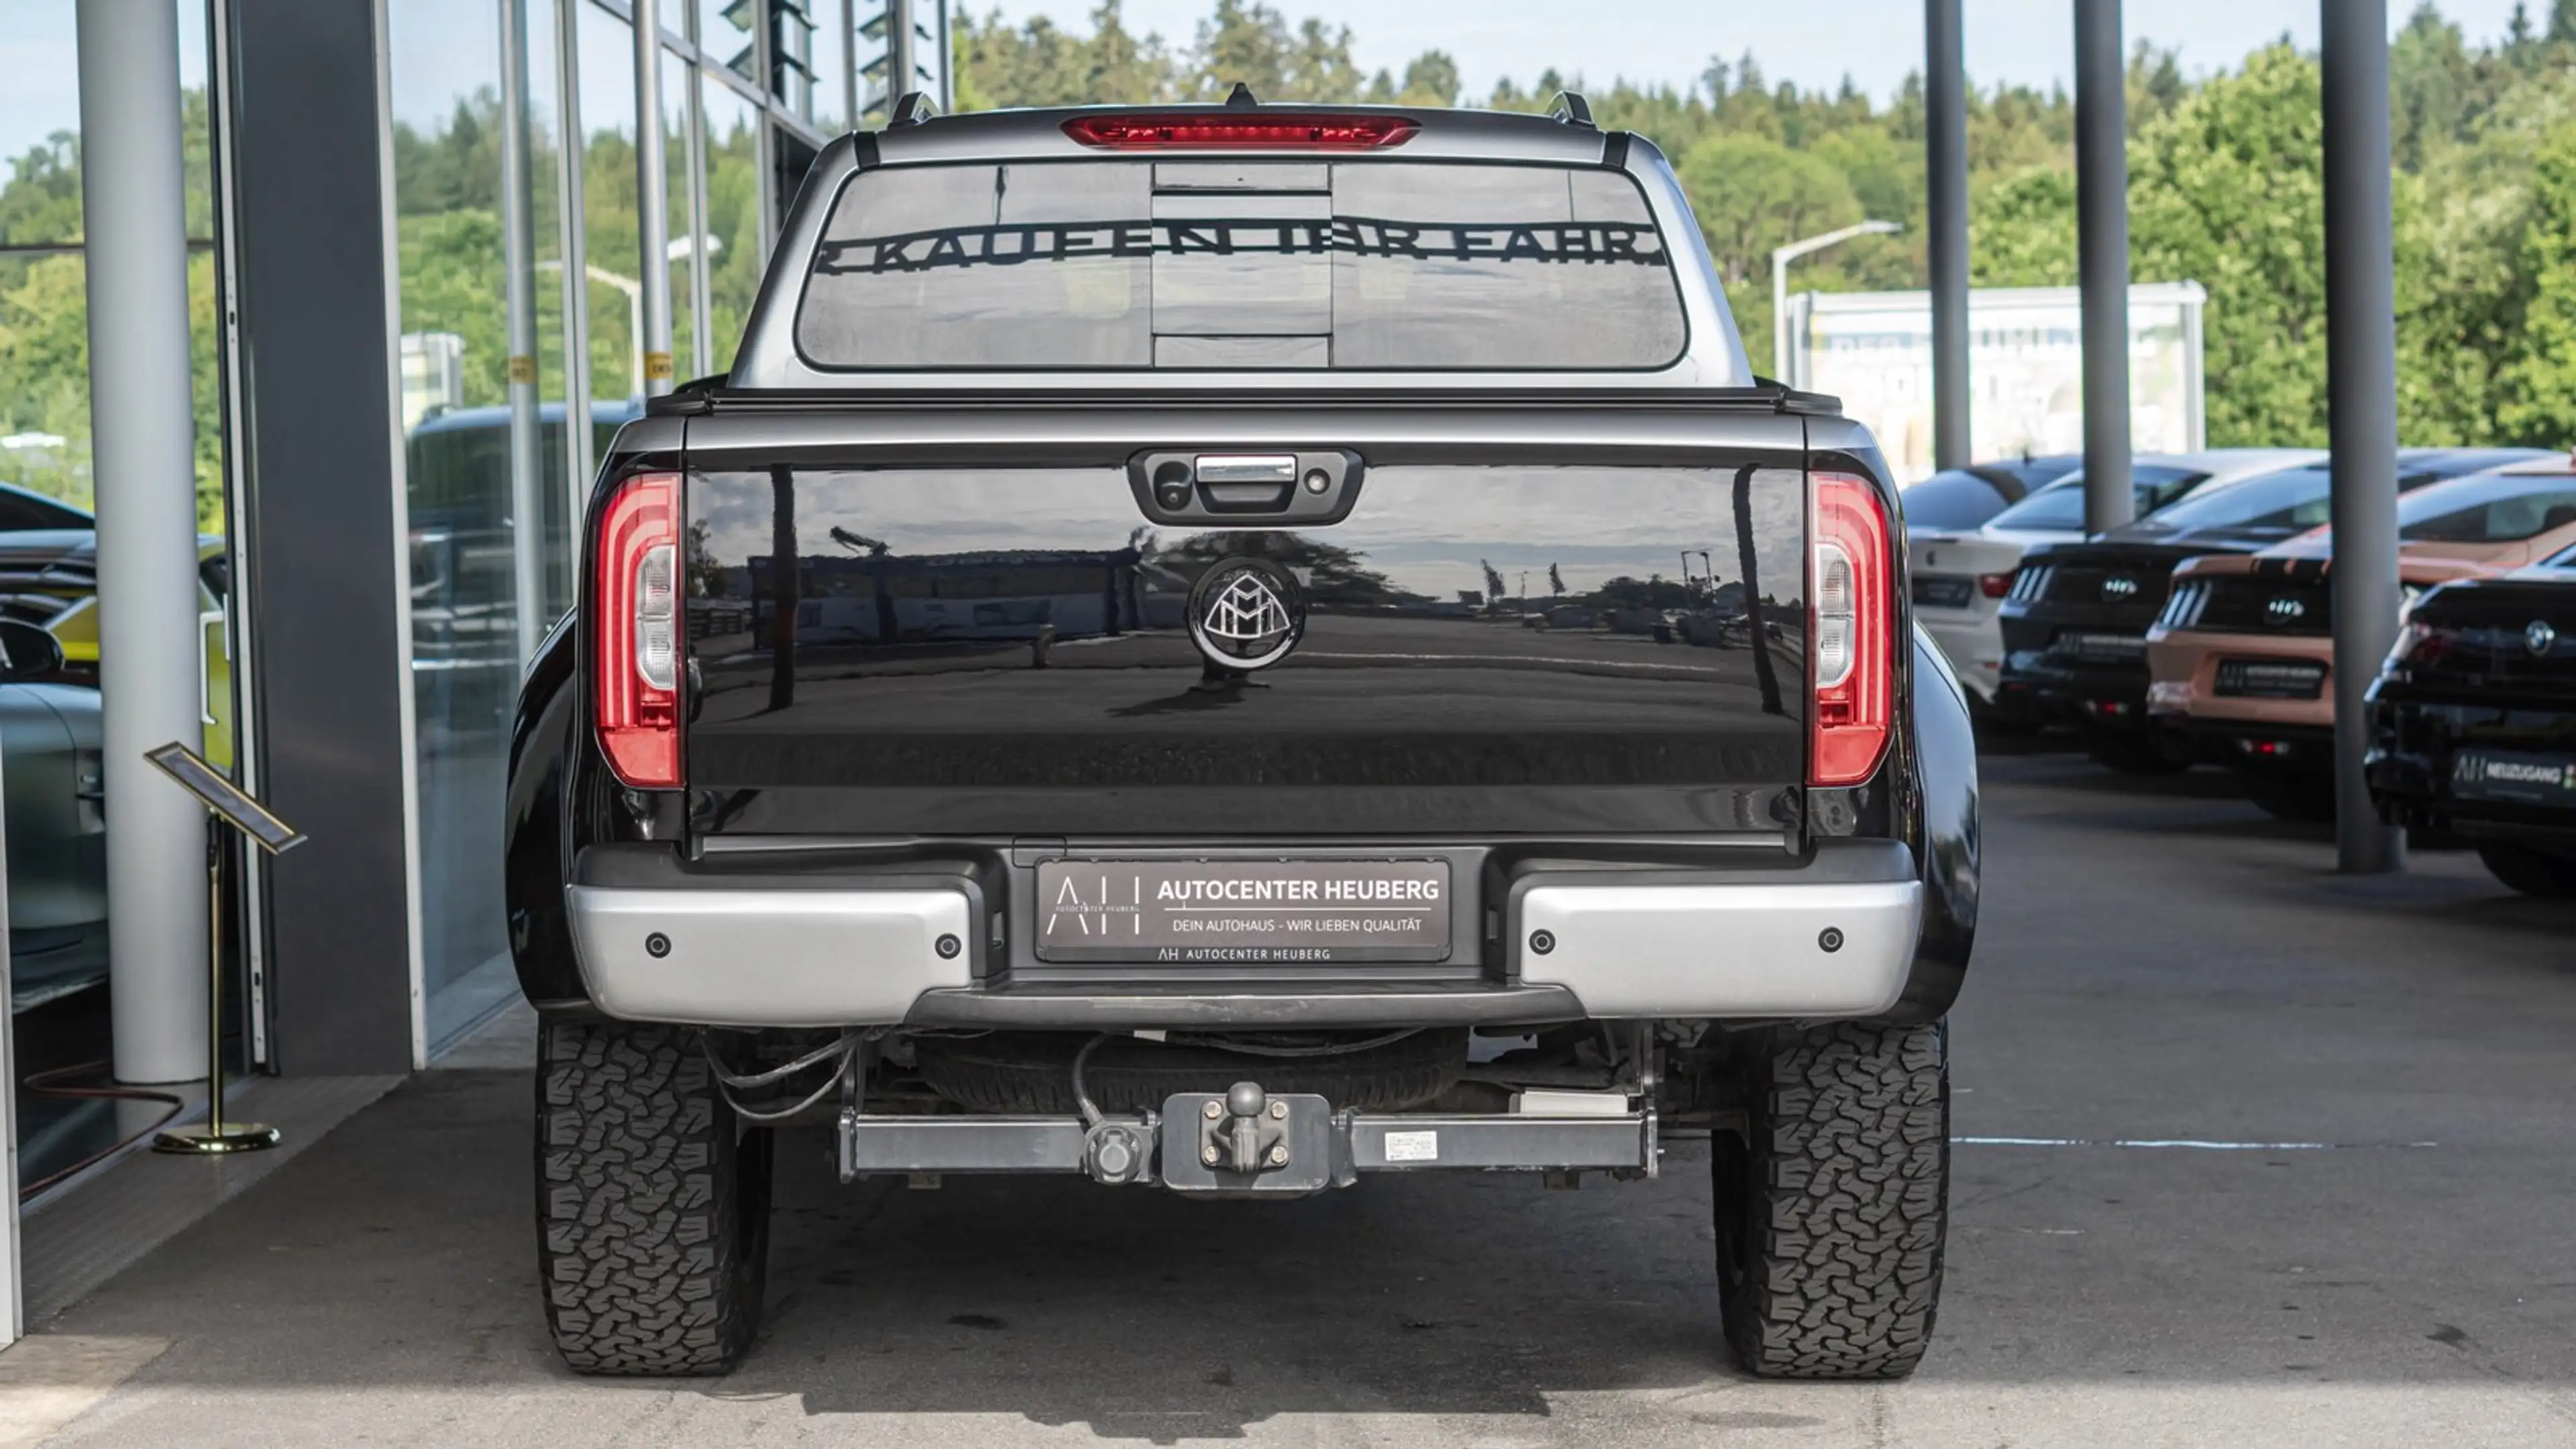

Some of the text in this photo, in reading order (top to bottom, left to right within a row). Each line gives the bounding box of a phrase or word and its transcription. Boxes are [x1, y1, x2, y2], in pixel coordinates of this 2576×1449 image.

[873, 219, 1234, 274] KAUFEN
[1279, 216, 1429, 260] IHR
[1449, 223, 1668, 266] FAHR
[1157, 879, 1439, 900] AUTOCENTER HEUBERG
[1173, 919, 1203, 932] DEIN
[1205, 919, 1275, 932] AUTOHAUS
[1286, 919, 1312, 932] WIR
[1315, 919, 1360, 932] LIEBEN
[1362, 918, 1422, 933] QUALITÄT
[1157, 948, 1330, 961] AH AUTOCENTER HEUBERG
